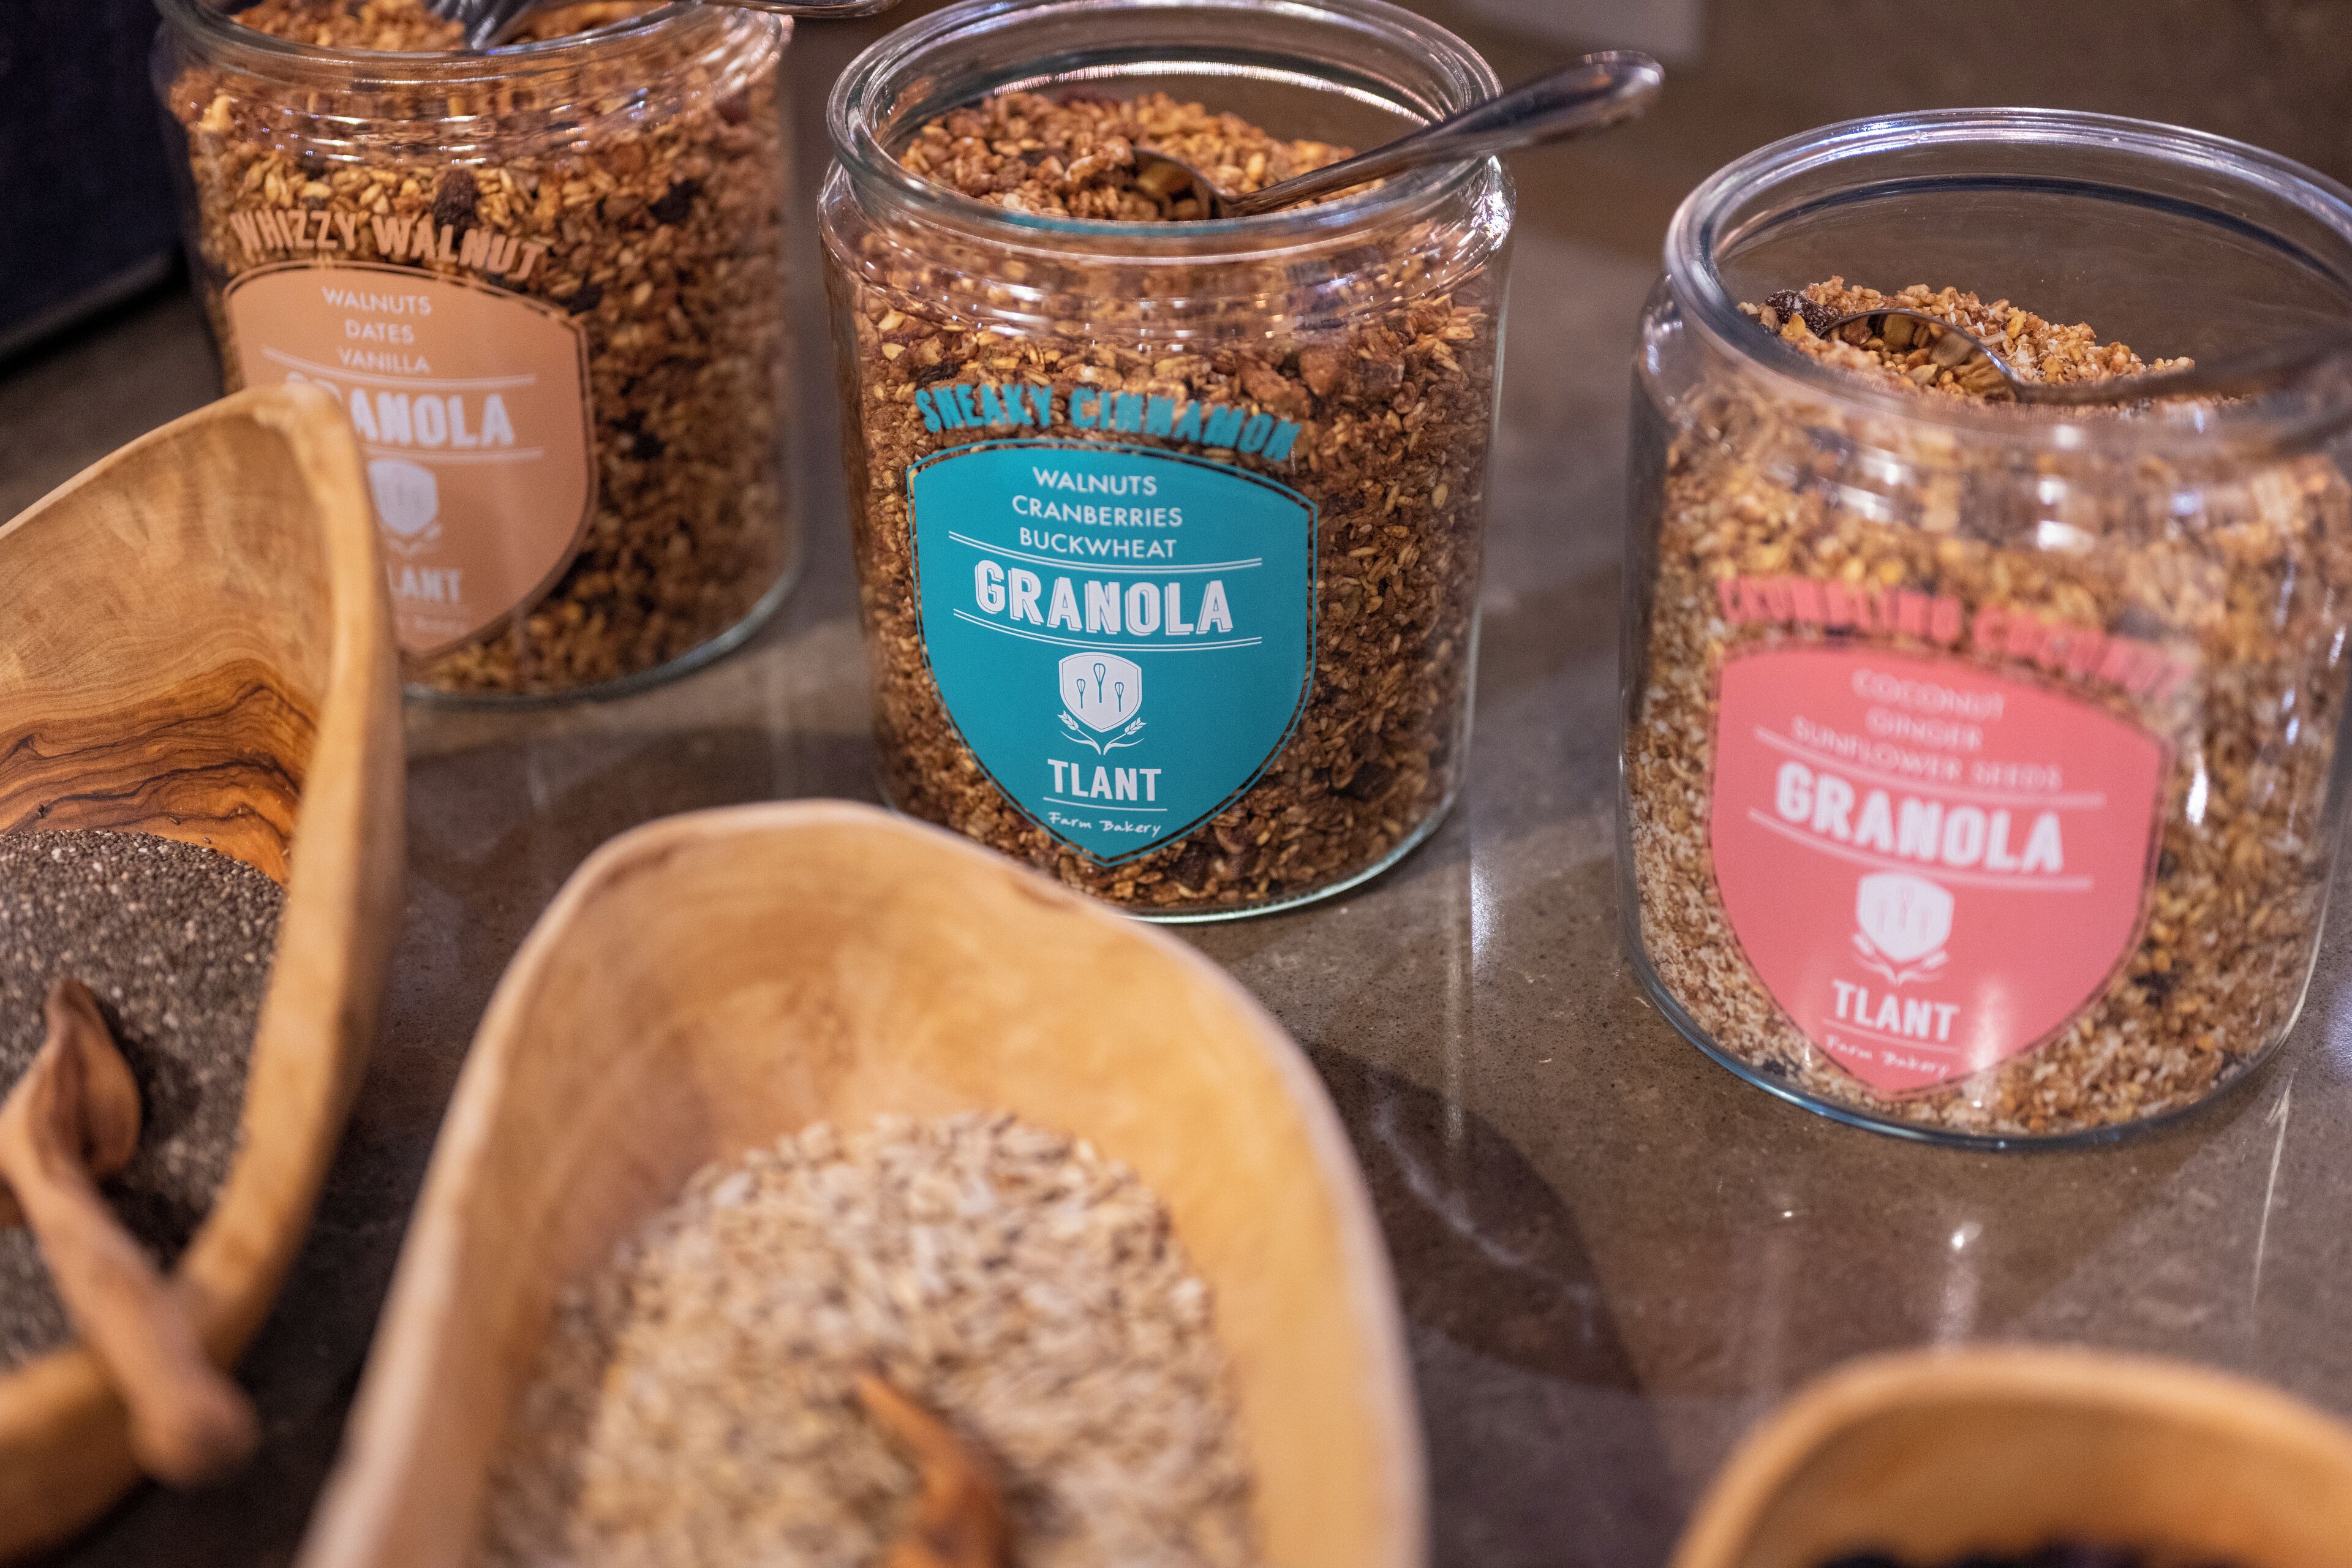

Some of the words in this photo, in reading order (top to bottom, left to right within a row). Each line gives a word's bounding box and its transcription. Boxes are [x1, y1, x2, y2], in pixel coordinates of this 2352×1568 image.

[230, 209, 357, 259] WHIZZY
[372, 215, 547, 280] WALNUT
[323, 286, 432, 315] WALNUTS
[345, 320, 415, 344] DATES
[338, 347, 431, 374] VANILLA
[286, 372, 515, 447] ANOLA
[916, 384, 1052, 432] SNEAKY
[1070, 388, 1302, 461] CINNAMON
[1033, 466, 1158, 496] WALNUTS
[1012, 496, 1183, 527] CRANBERRIES
[1019, 527, 1177, 559] BUCKWHEAT
[975, 560, 1234, 636] GRANOLA
[1852, 668, 2005, 722] COCONUT
[1866, 707, 1983, 753] GINGER
[1792, 716, 1961, 782] SUNFLOWER
[1971, 758, 2062, 790] SEEDS
[1047, 758, 1162, 801] TLANT
[1048, 812, 1092, 829] Farm
[1102, 820, 1162, 838] Bakery
[1776, 761, 2065, 873] GRANOLA
[1833, 979, 1959, 1042] TLANT
[1825, 1033, 1873, 1061] Farm
